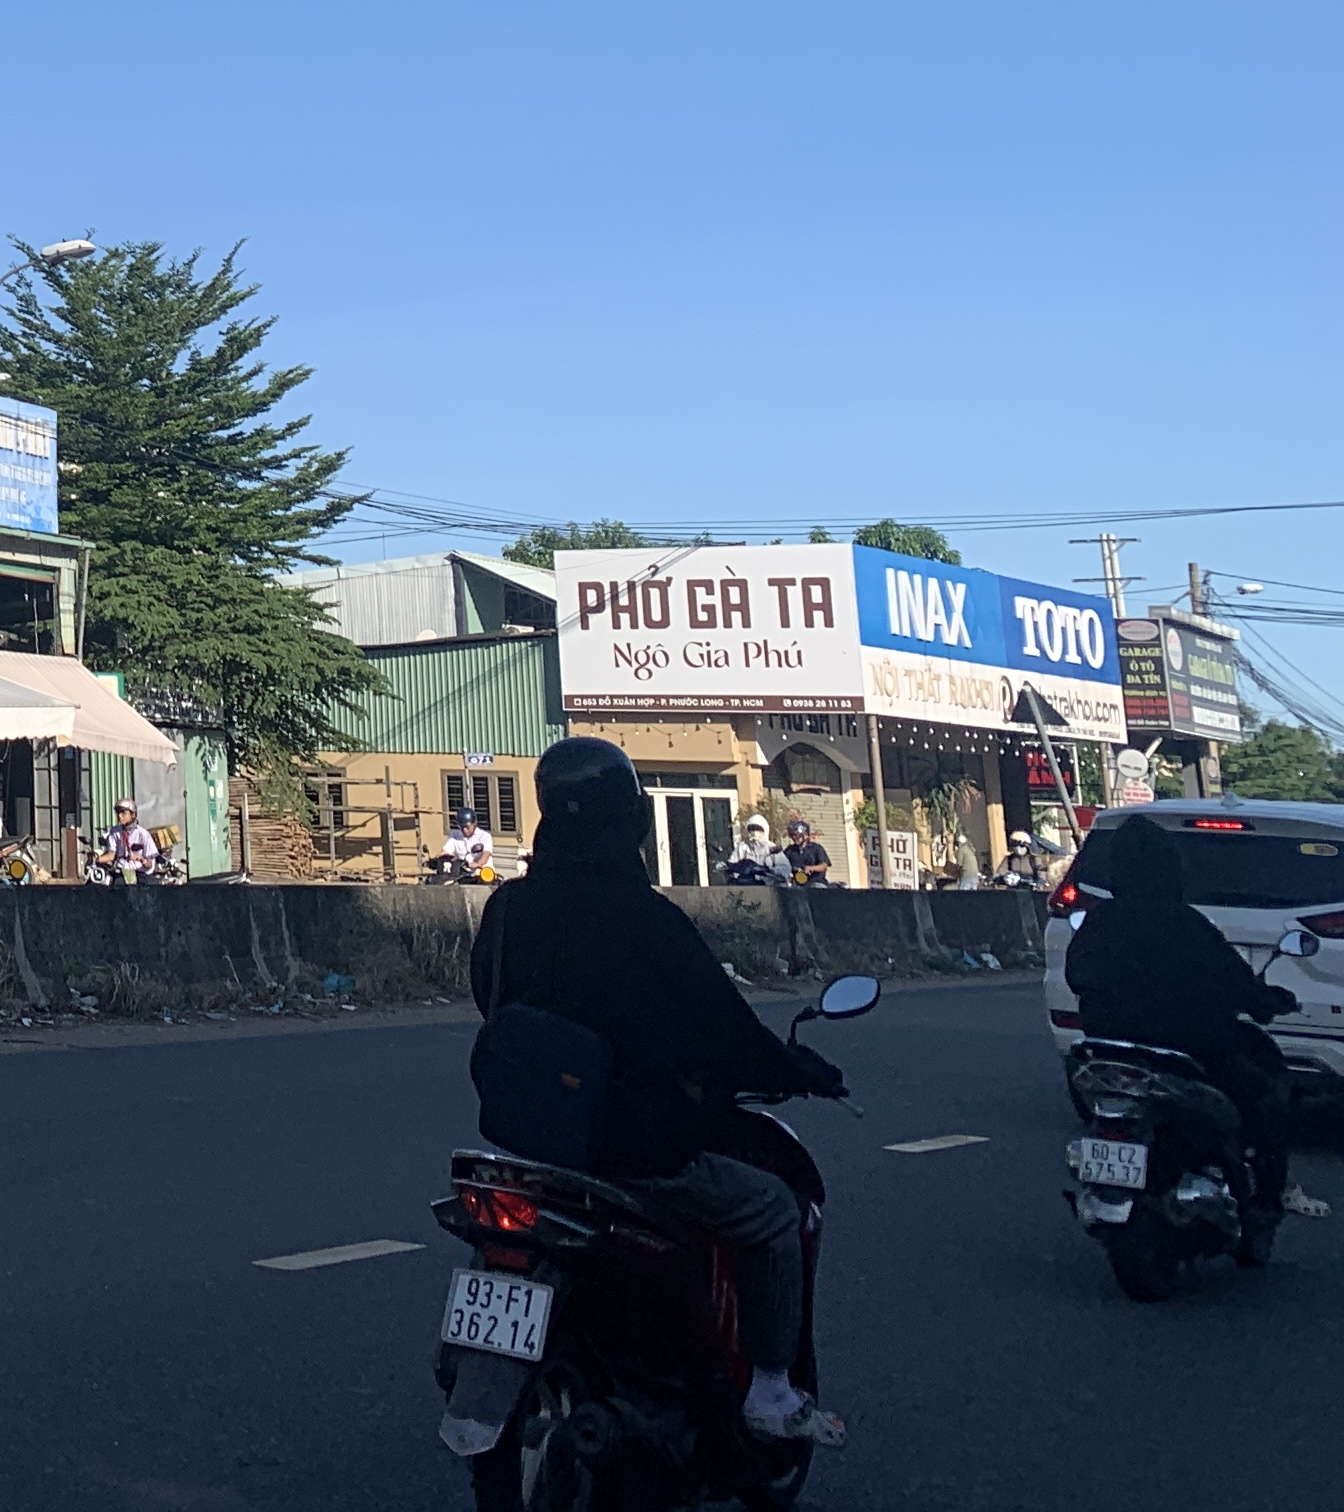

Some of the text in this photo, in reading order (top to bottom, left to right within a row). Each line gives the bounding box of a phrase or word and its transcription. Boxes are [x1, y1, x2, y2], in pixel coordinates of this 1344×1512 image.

[577, 563, 835, 631] PHỞ GÀ TA
[885, 567, 973, 649] INAX
[1014, 596, 1105, 670] TOTO
[1119, 647, 1162, 657] GARAGE
[613, 639, 804, 681] Ngô Gia Phú
[869, 657, 900, 707] NỘI
[1129, 659, 1155, 672] Ô TÔ
[598, 695, 612, 707] ĐỖ
[612, 696, 636, 707] XUÂN
[637, 697, 655, 708] HỢP
[669, 696, 699, 708] PHƯỚC
[700, 698, 724, 707] LONG
[743, 699, 764, 708] HCM
[465, 1277, 534, 1318] 93-F1
[449, 1308, 536, 1356] 362.14
